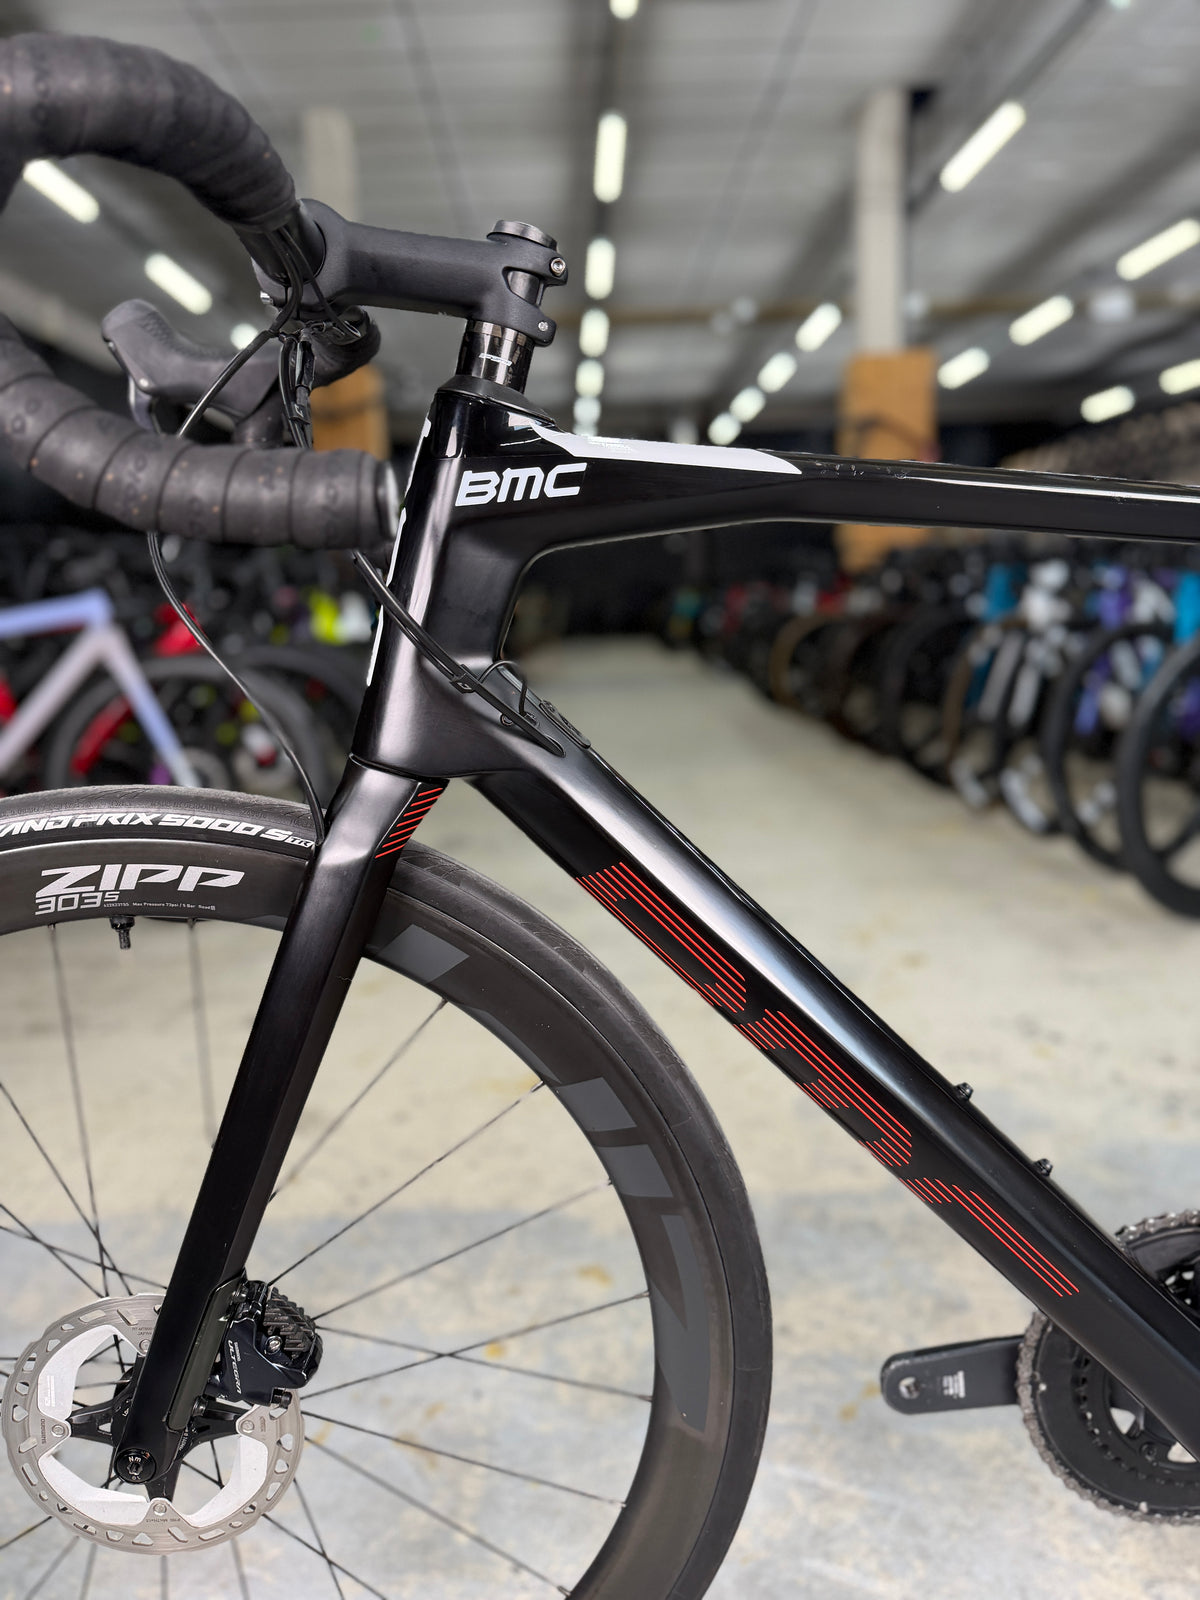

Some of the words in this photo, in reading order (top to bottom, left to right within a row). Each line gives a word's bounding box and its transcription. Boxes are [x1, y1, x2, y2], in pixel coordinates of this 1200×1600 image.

[455, 462, 587, 507] BMC
[0, 815, 73, 837] AND
[72, 812, 160, 828] PRIX
[158, 813, 265, 836] 5000
[259, 828, 293, 841] S
[35, 863, 246, 898] ZIPP
[227, 1339, 242, 1395] ULTEGRA
